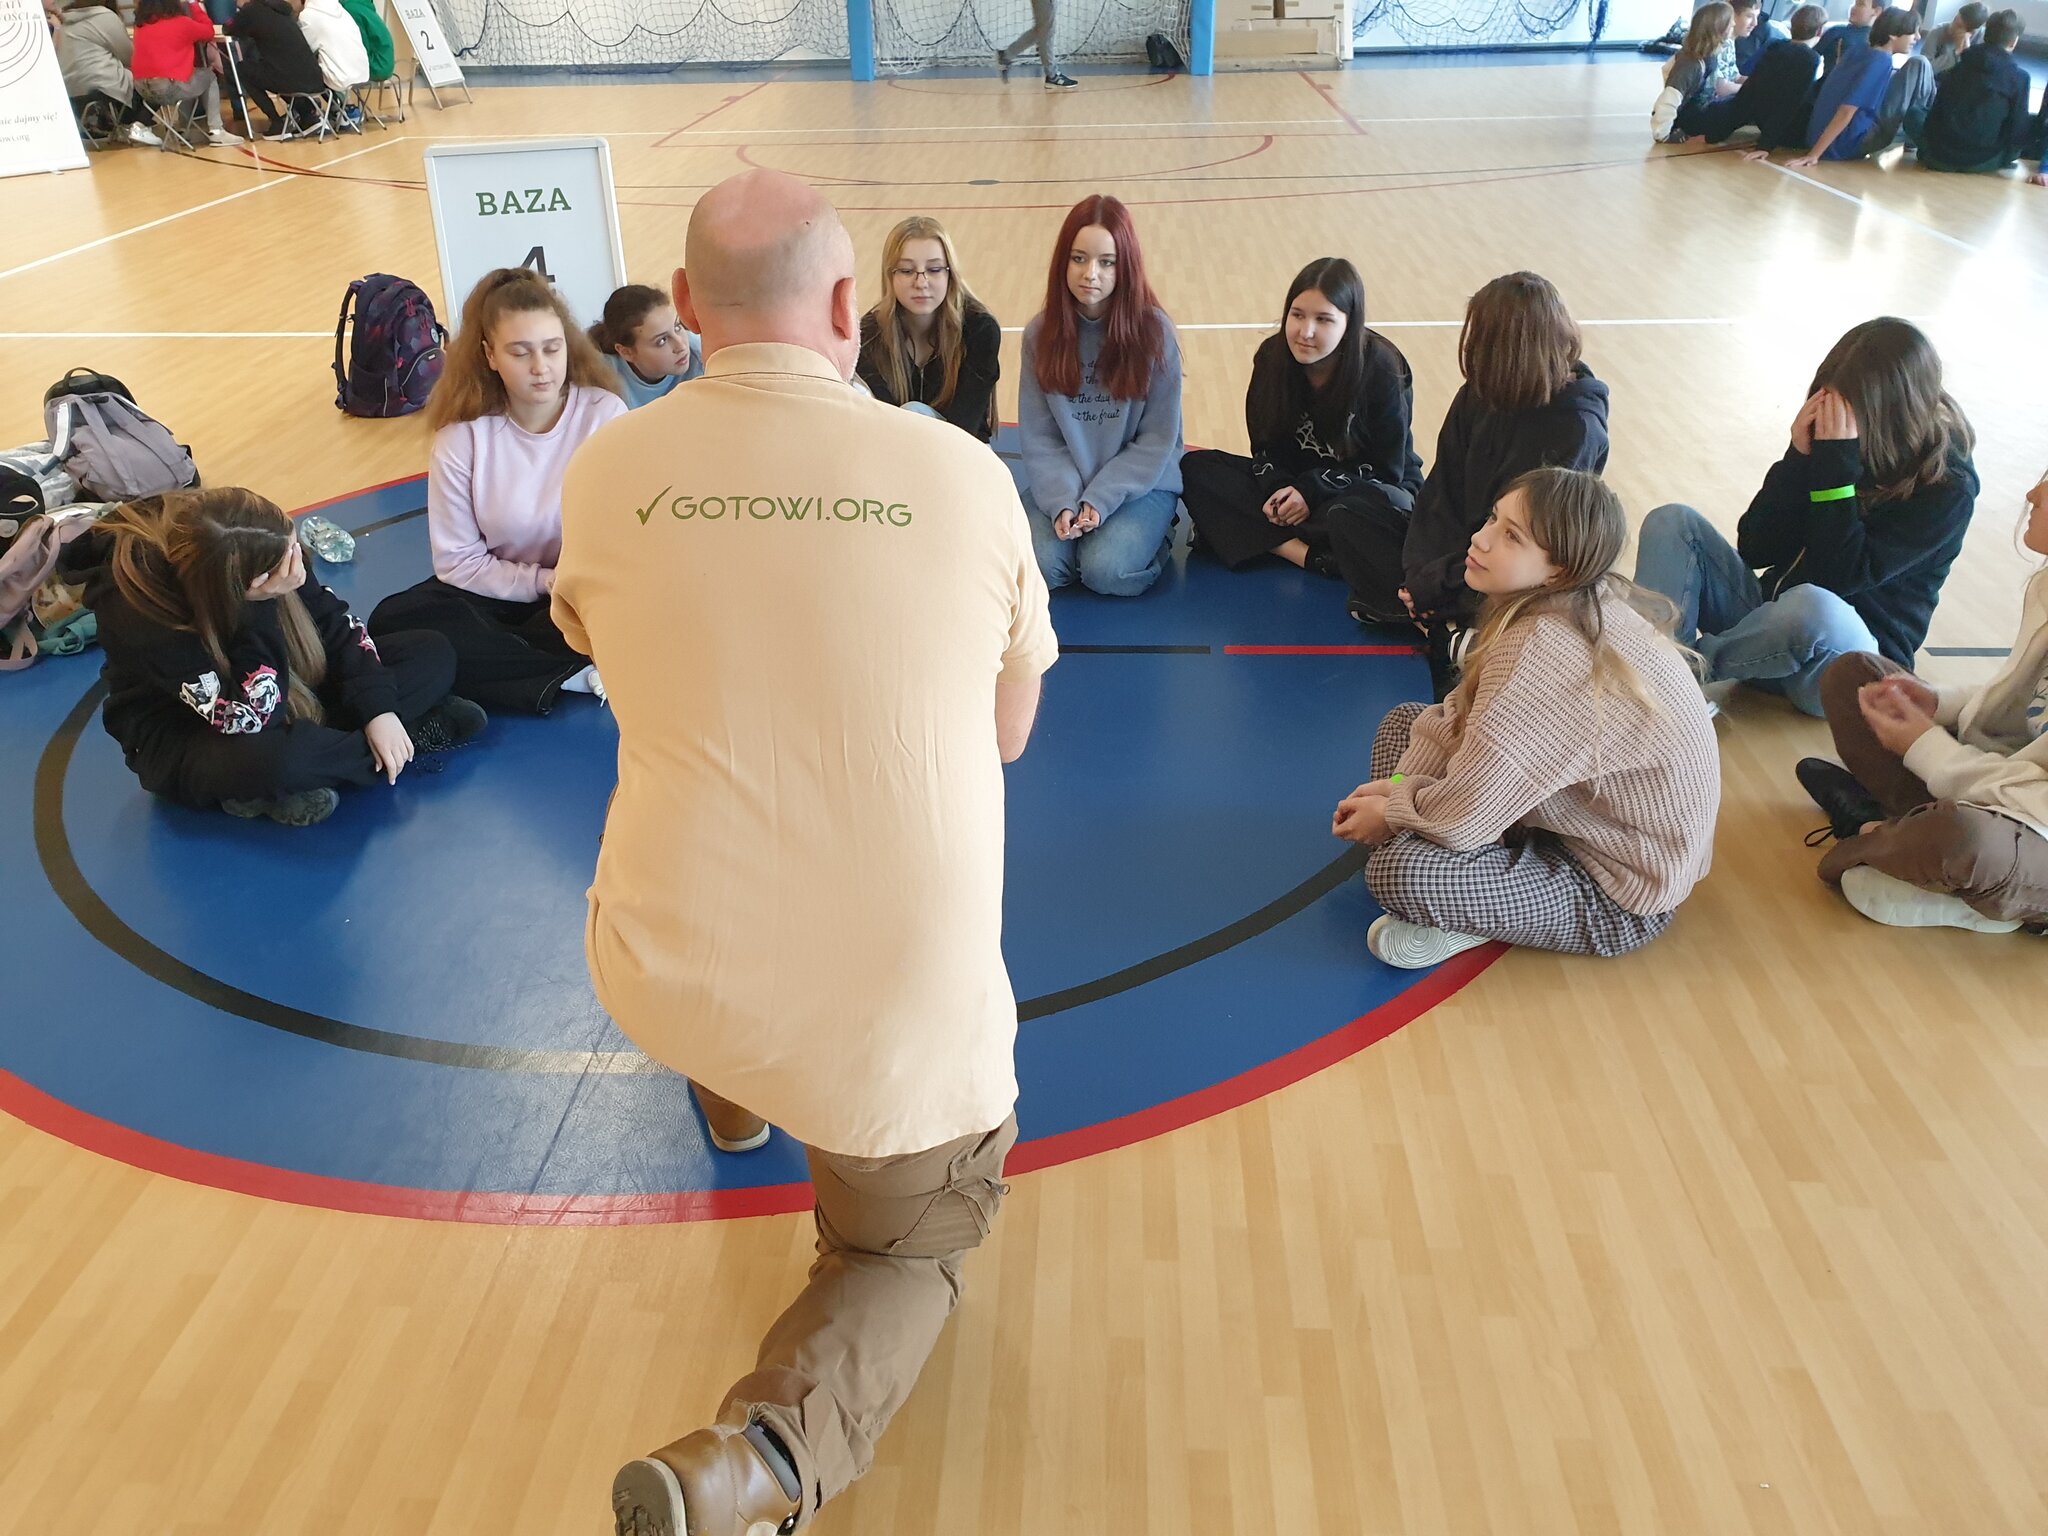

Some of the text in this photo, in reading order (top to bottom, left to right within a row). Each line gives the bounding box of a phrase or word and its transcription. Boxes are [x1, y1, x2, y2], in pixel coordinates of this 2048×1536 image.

[420, 30, 435, 50] 2
[475, 187, 572, 216] BAZA
[512, 246, 556, 287] 4
[1082, 410, 1098, 422] the
[671, 496, 912, 527] GOTOWI.ORG
